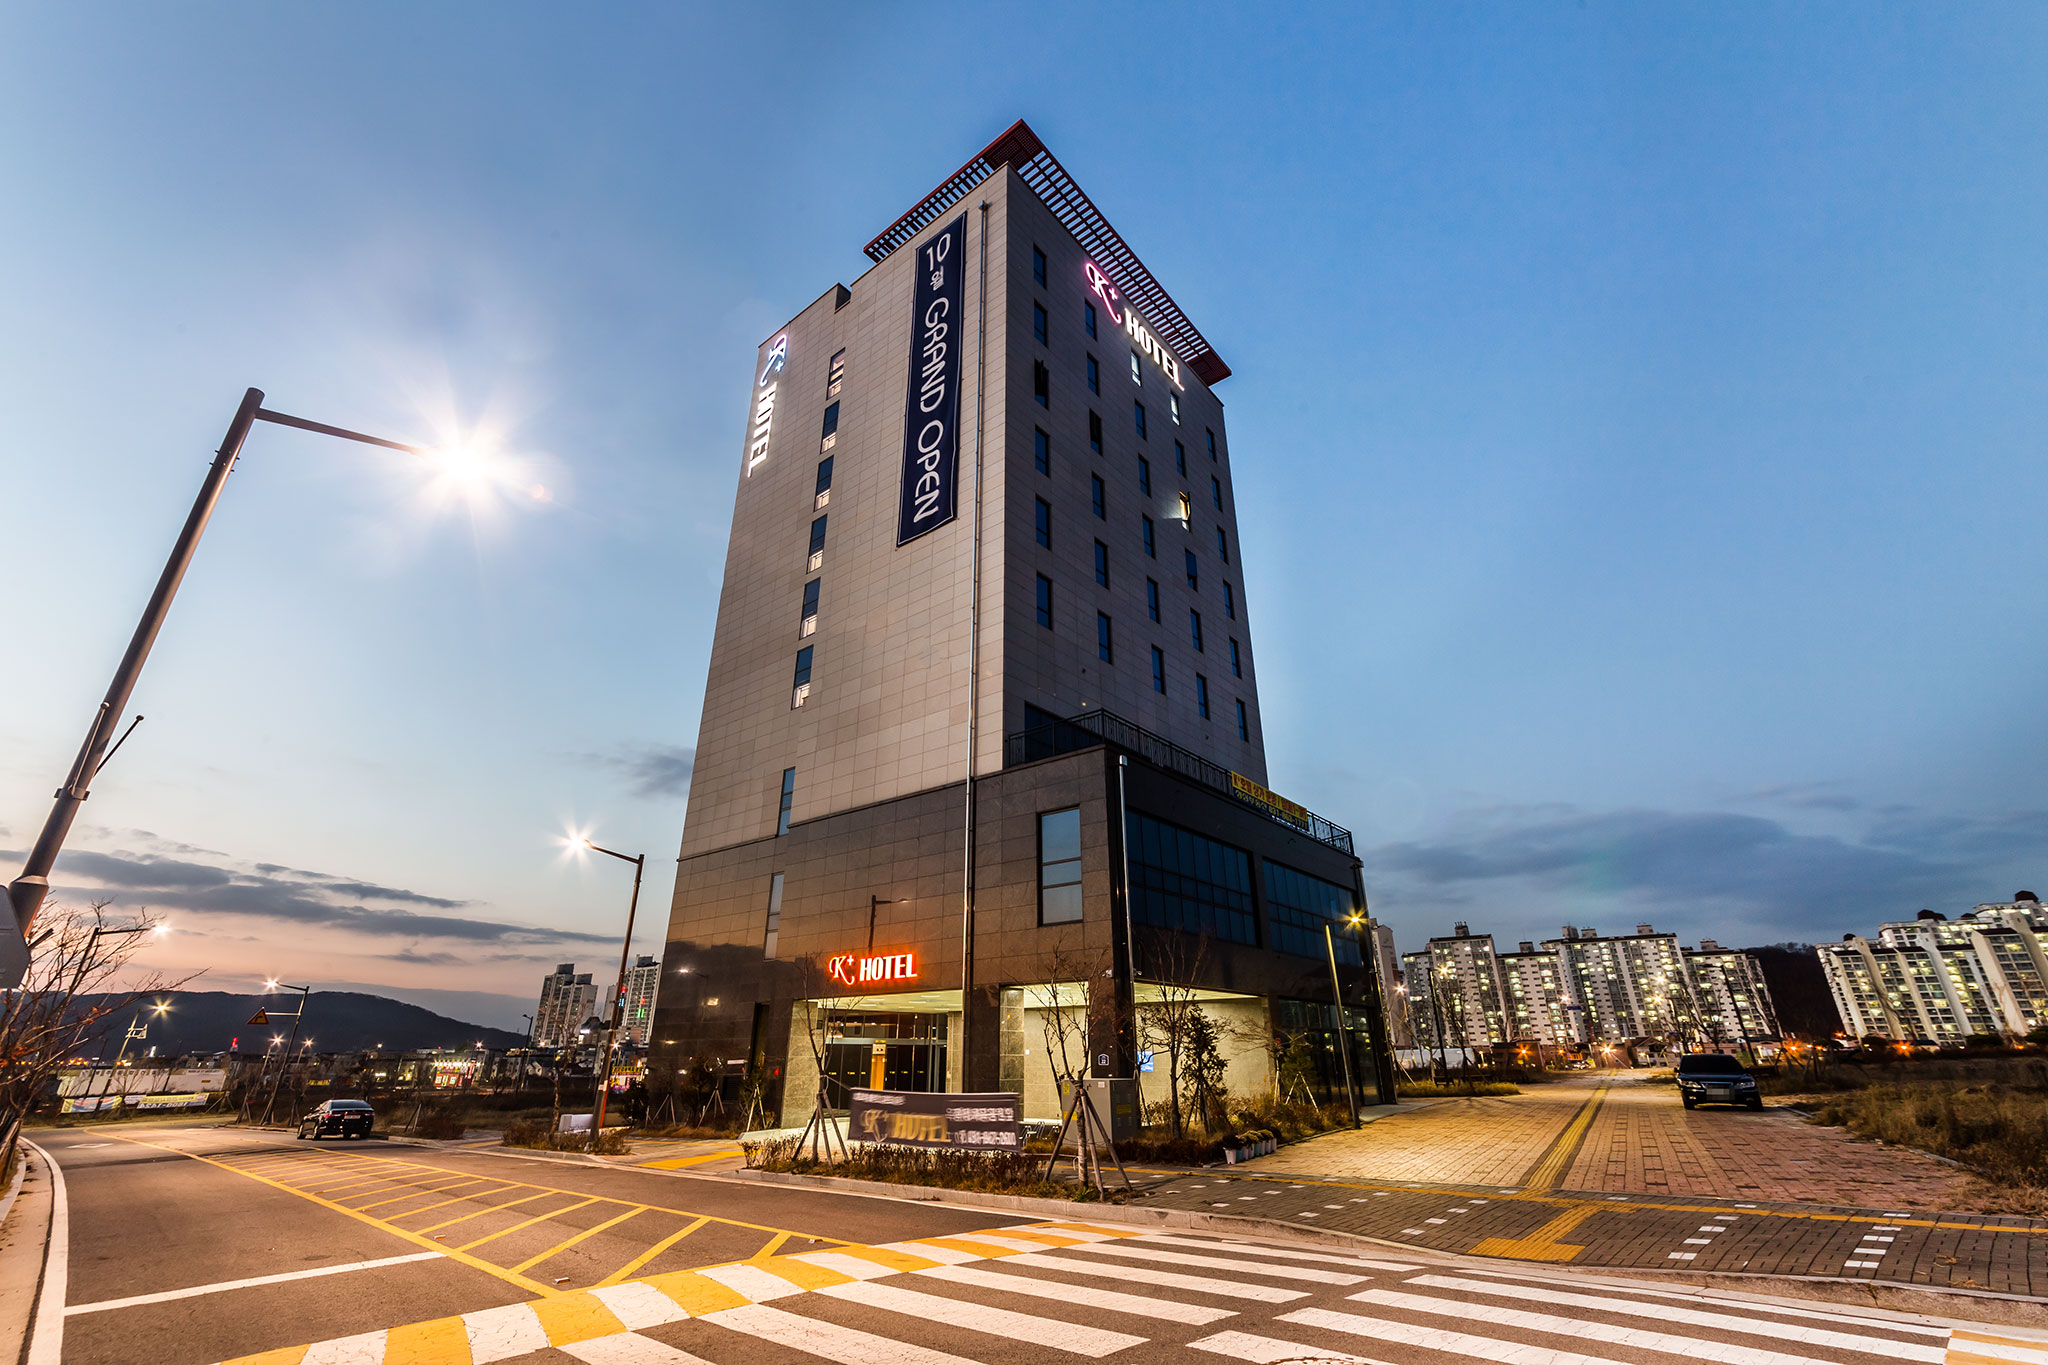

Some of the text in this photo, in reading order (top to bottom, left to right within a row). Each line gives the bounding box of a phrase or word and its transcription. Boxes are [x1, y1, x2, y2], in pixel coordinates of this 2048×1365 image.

[920, 297, 950, 413] GRAND
[1125, 307, 1185, 392] HOTEL
[747, 381, 778, 478] HOTEL
[913, 419, 944, 524] OPEN
[859, 953, 918, 982] HOTEL
